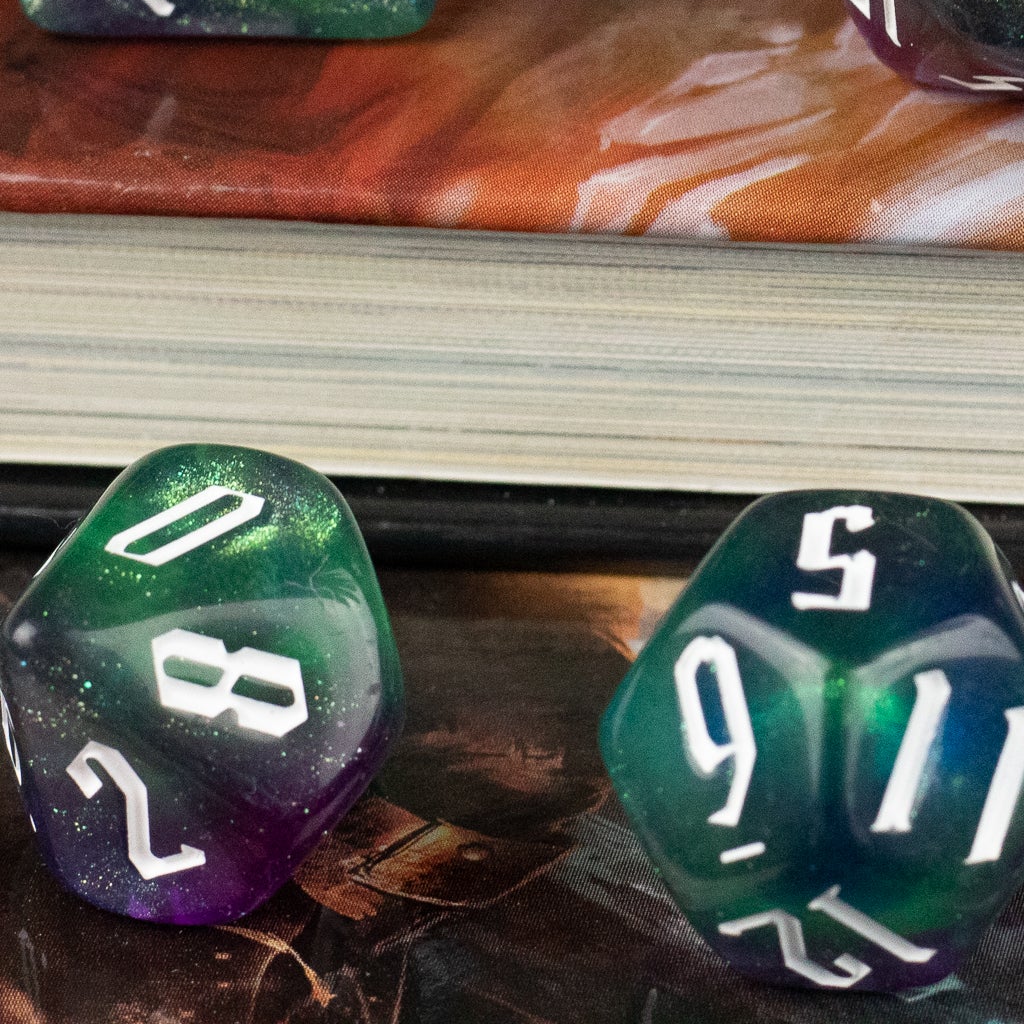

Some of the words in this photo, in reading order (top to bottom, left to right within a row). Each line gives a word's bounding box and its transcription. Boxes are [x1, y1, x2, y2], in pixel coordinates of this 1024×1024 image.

[104, 484, 266, 568] 0
[790, 504, 877, 612] 5
[150, 627, 310, 739] 8
[673, 634, 767, 865] 9
[65, 739, 207, 881] 2
[717, 883, 938, 989] 12
